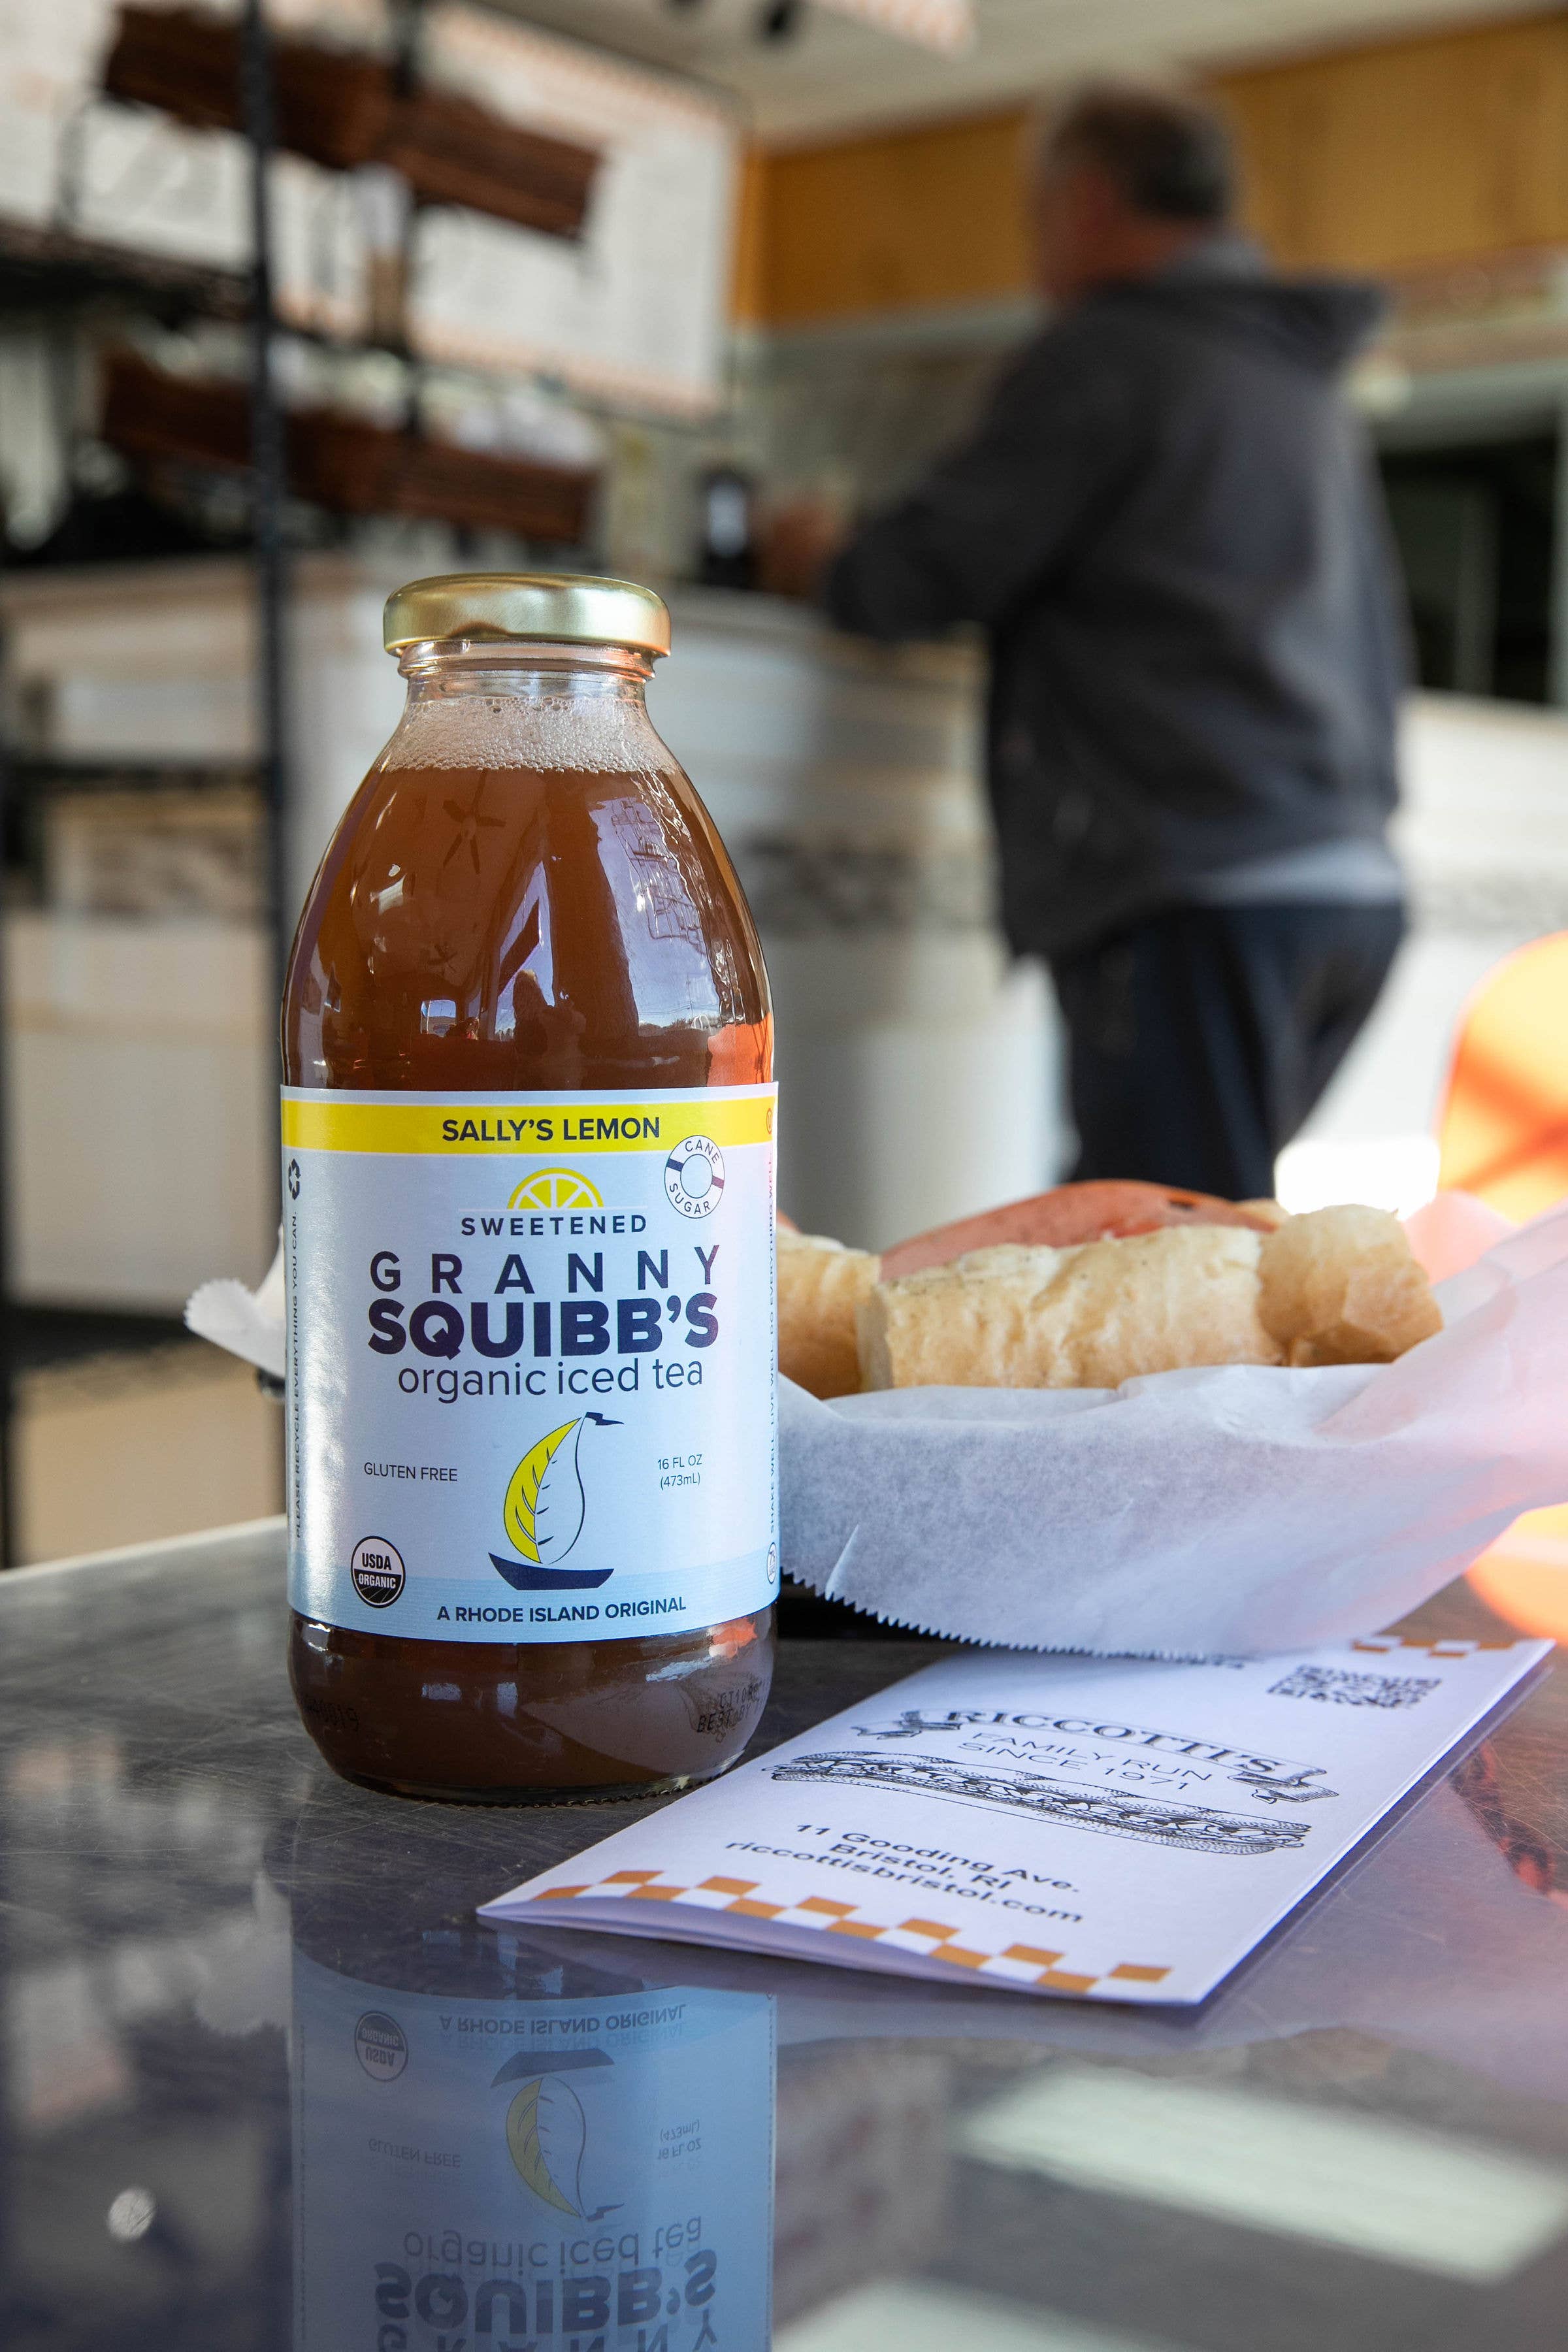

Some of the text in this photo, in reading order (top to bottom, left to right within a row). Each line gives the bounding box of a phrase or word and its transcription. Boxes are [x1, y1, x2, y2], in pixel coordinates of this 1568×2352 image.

[442, 1117, 660, 1142] SALLY'S LEMON
[685, 1139, 719, 1164] CANE
[670, 1183, 710, 1215] SUGAR
[461, 1215, 646, 1236] SWEETENED
[370, 1245, 720, 1294] GRANNY
[368, 1292, 718, 1360] SQUIBB'S
[399, 1358, 703, 1403] organic iced tea
[364, 1461, 458, 1482] GLUTEN FREE
[657, 1454, 702, 1471] 16 FL OZ
[659, 1473, 701, 1490] (473mL)
[361, 1552, 392, 1571] USDA
[358, 1573, 397, 1589] ORGANIC
[437, 1596, 687, 1622] A RHODE ISLAND ORIGINAL
[946, 1712, 1286, 1774] RICCOTTI'S
[972, 1733, 1212, 1781] FAMILY RUN
[958, 1742, 1190, 1789] SINCE 1971
[795, 1824, 1079, 1892] 11 Gooding Ave.
[829, 1843, 1011, 1889] Bristol, RI
[725, 1842, 1083, 1923] riccottisbristol.com
